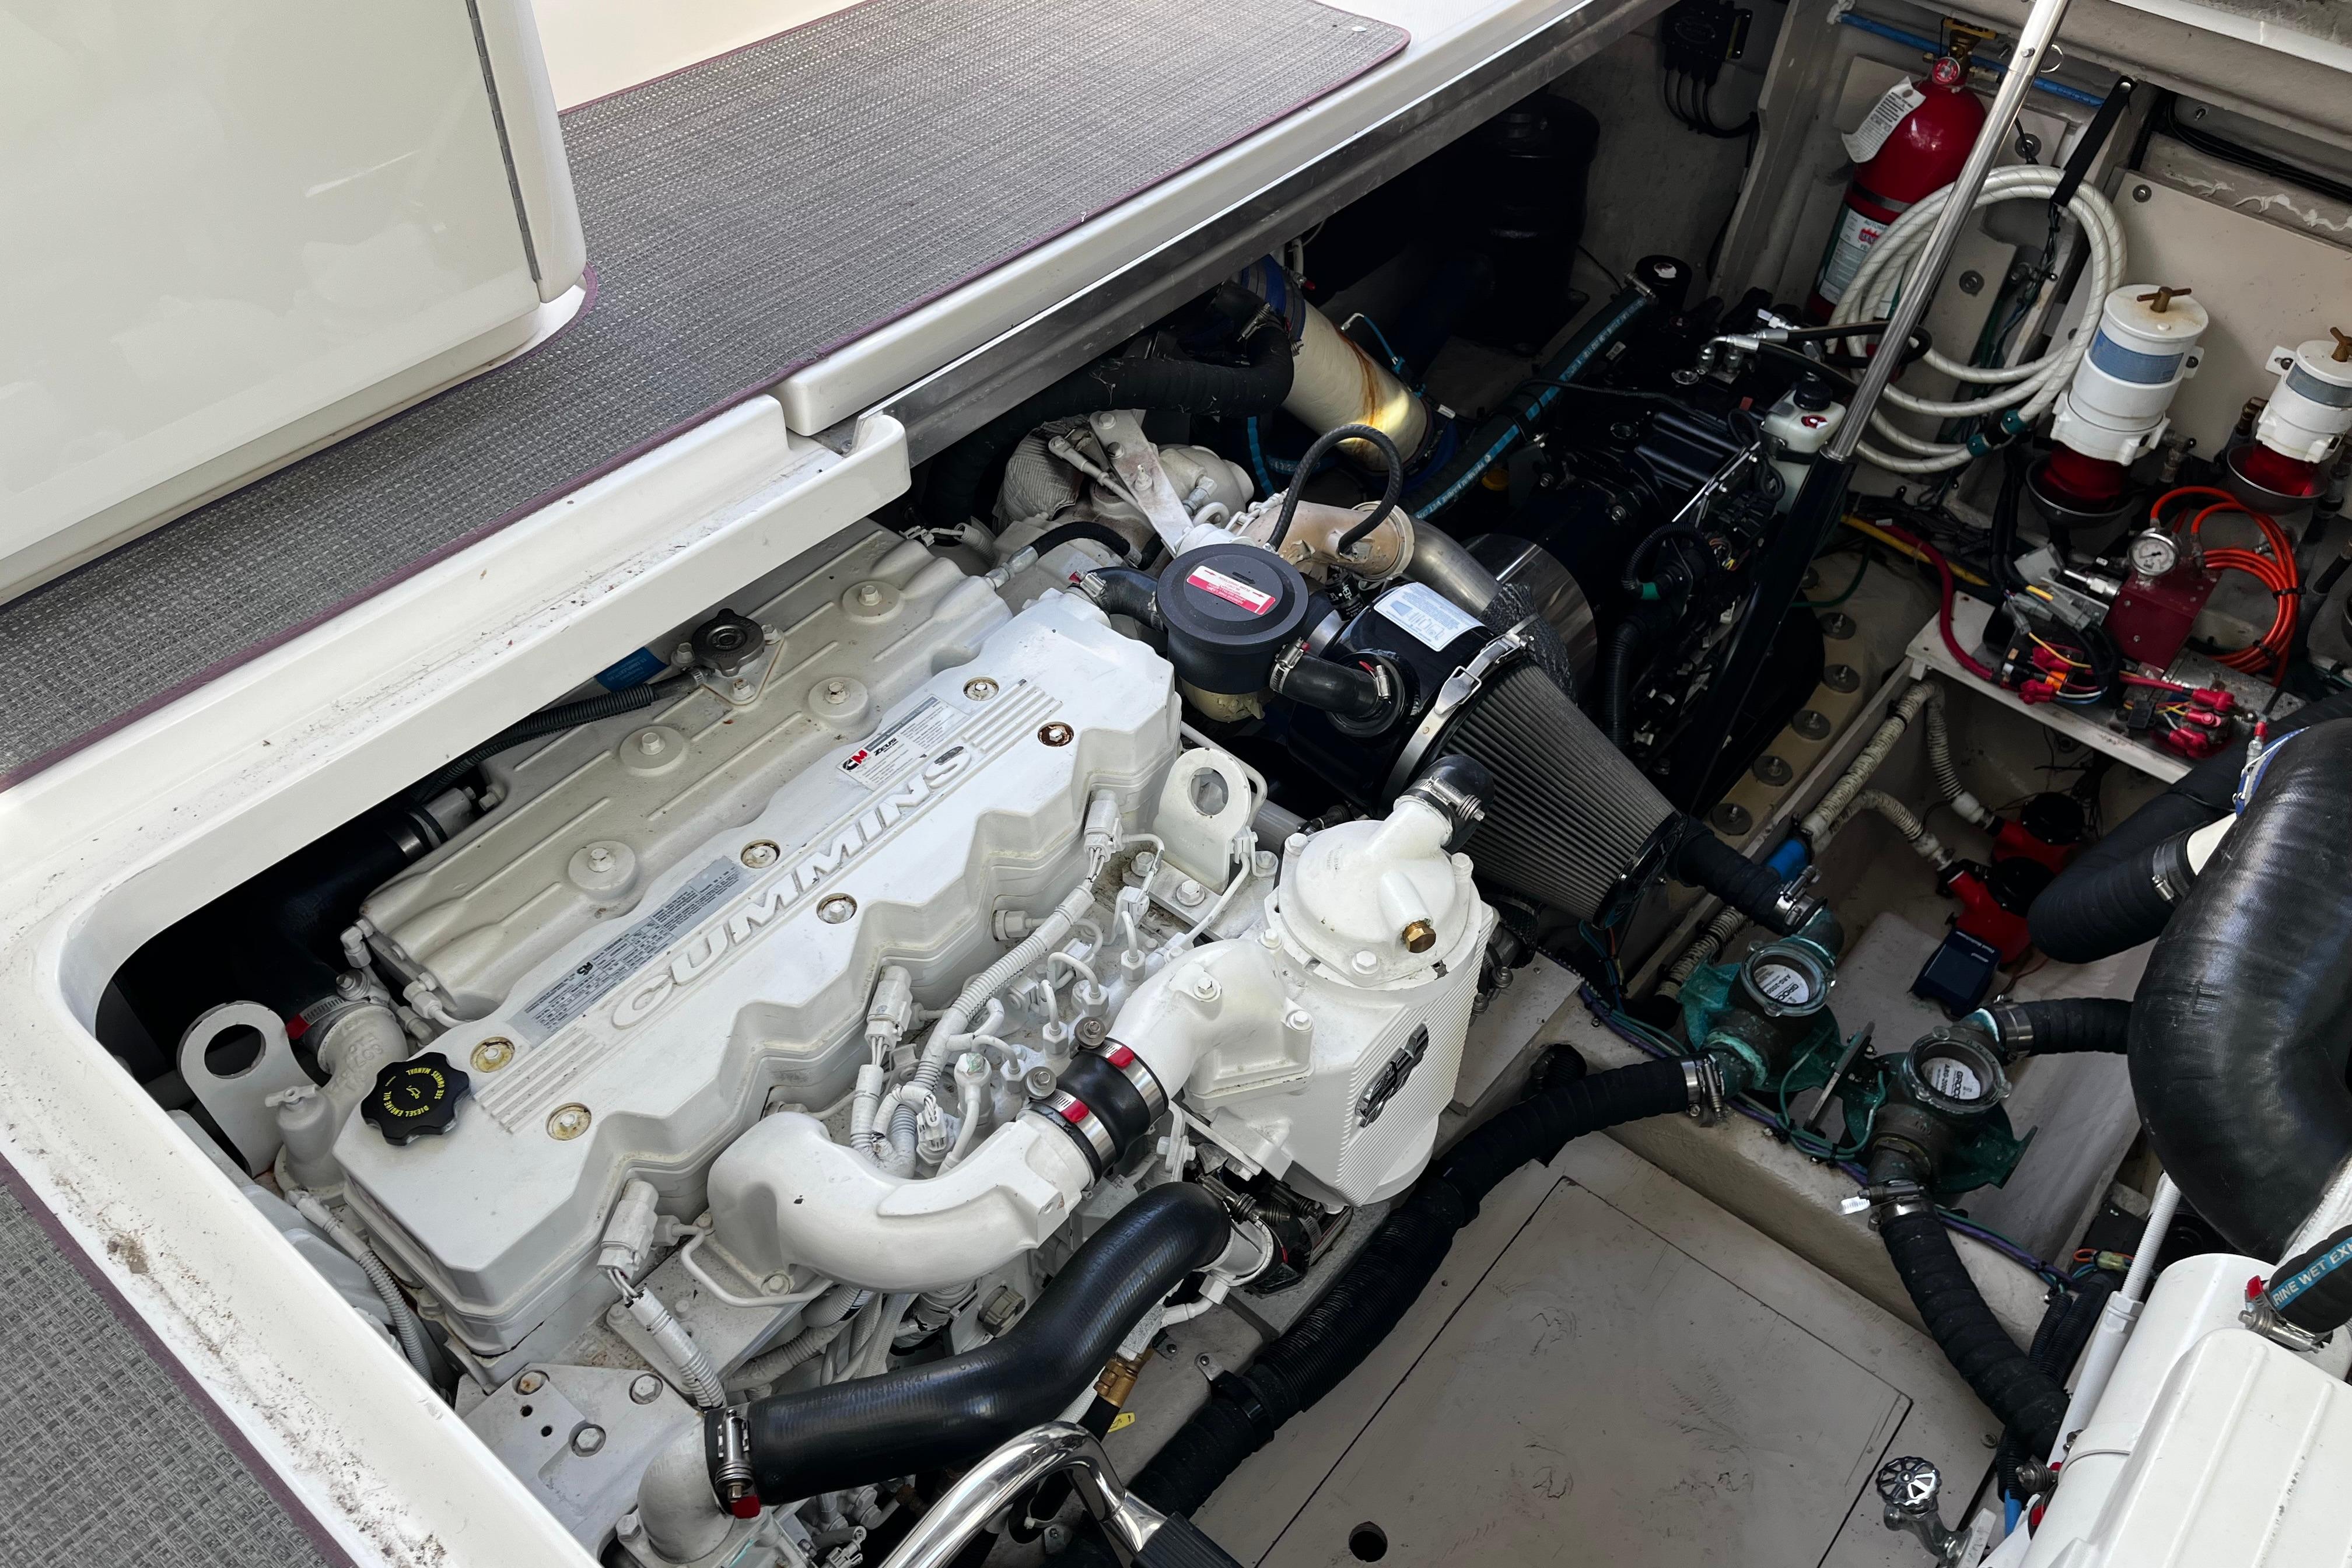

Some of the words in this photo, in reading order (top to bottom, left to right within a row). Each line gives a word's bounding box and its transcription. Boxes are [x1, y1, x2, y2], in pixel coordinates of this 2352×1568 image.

[874, 737, 898, 757] ZEUS
[611, 745, 971, 1029] CUMMINS
[1777, 984, 1800, 1001] GROC
[405, 1067, 432, 1076] MANUAL
[383, 1090, 392, 1101] OIL
[434, 1089, 445, 1100] SEE
[383, 1101, 404, 1116] ENGINE
[405, 1105, 430, 1117] DIESEL
[2273, 1280, 2300, 1307] RINE
[2298, 1259, 2327, 1285] WET
